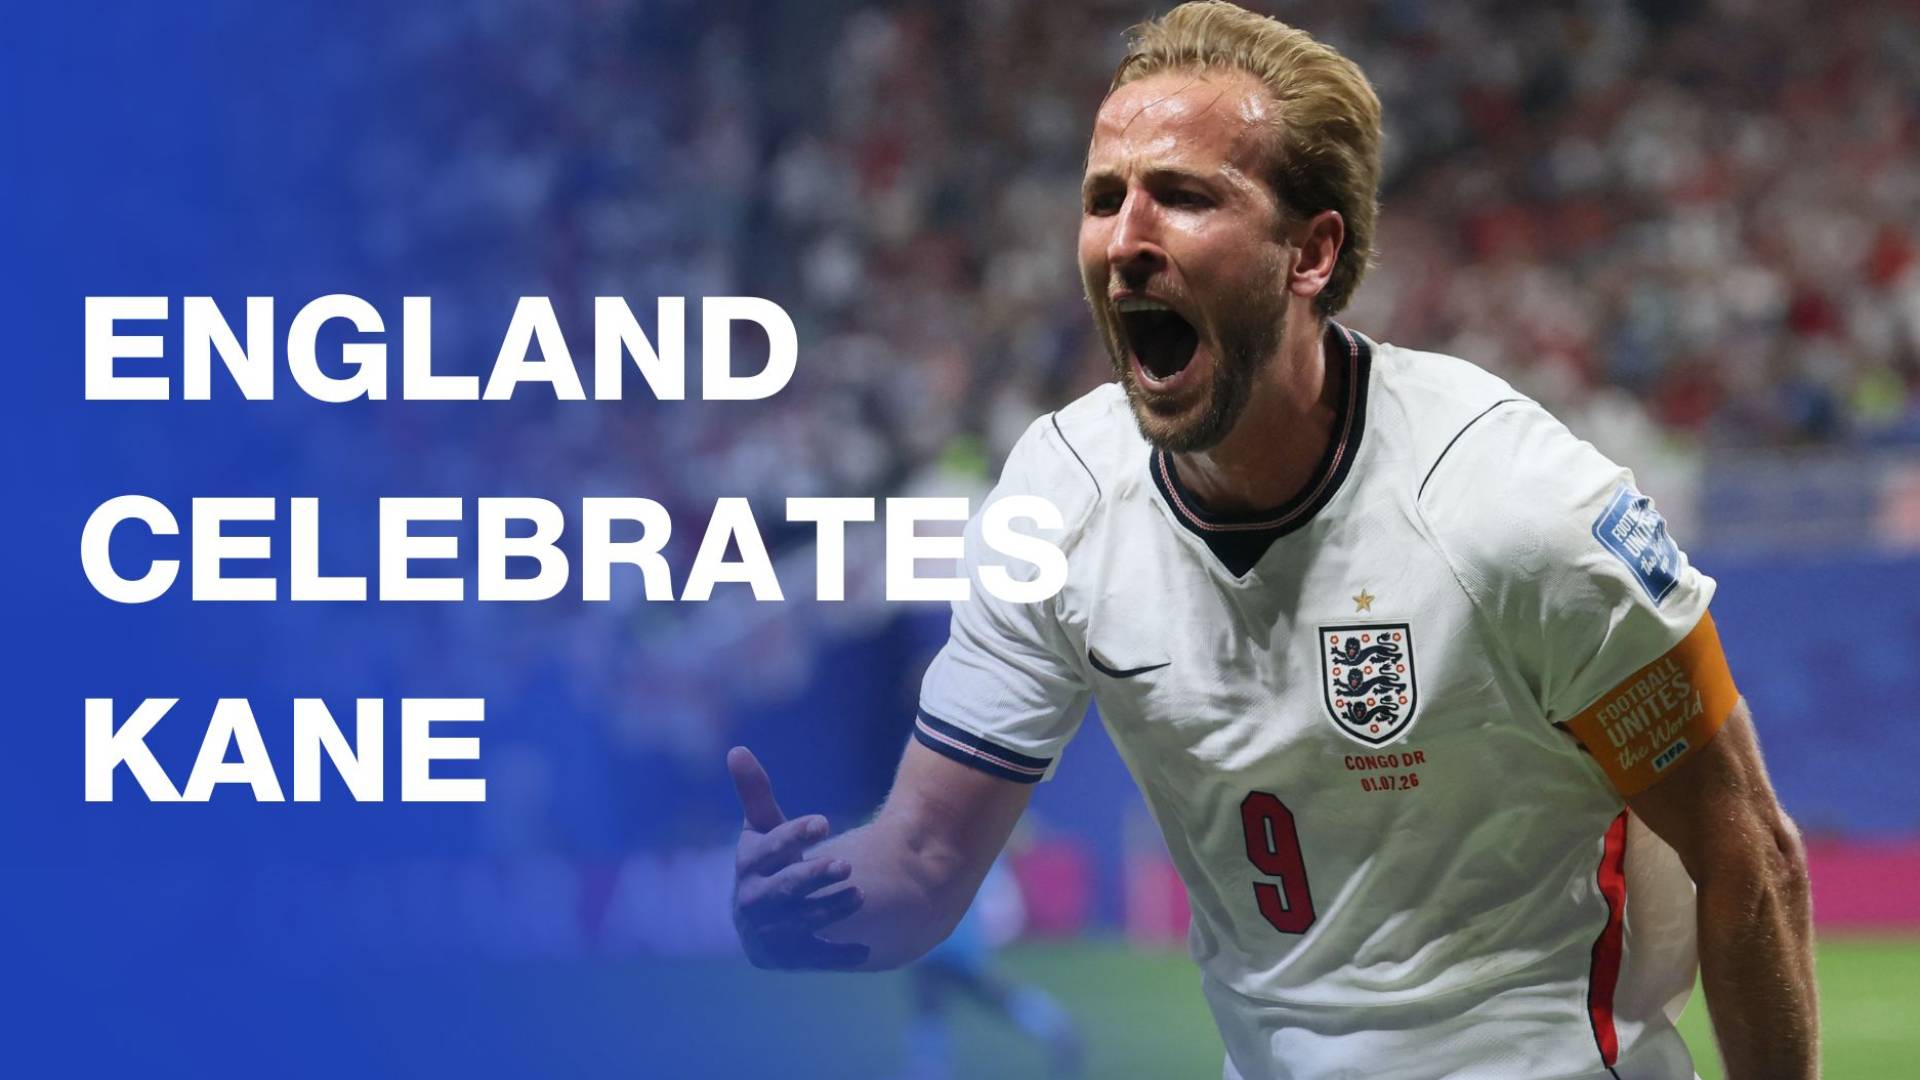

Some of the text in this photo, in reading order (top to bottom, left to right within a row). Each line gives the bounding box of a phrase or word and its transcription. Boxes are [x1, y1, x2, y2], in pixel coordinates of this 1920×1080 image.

[1597, 658, 1680, 728] FOOTBALL
[1606, 673, 1691, 748] UNITES
[1345, 750, 1426, 771] CONGO DR
[1617, 690, 1704, 770] the World
[1655, 741, 1687, 769] FIFA
[1361, 773, 1419, 792] 01.07.26
[1240, 790, 1316, 934] 9
